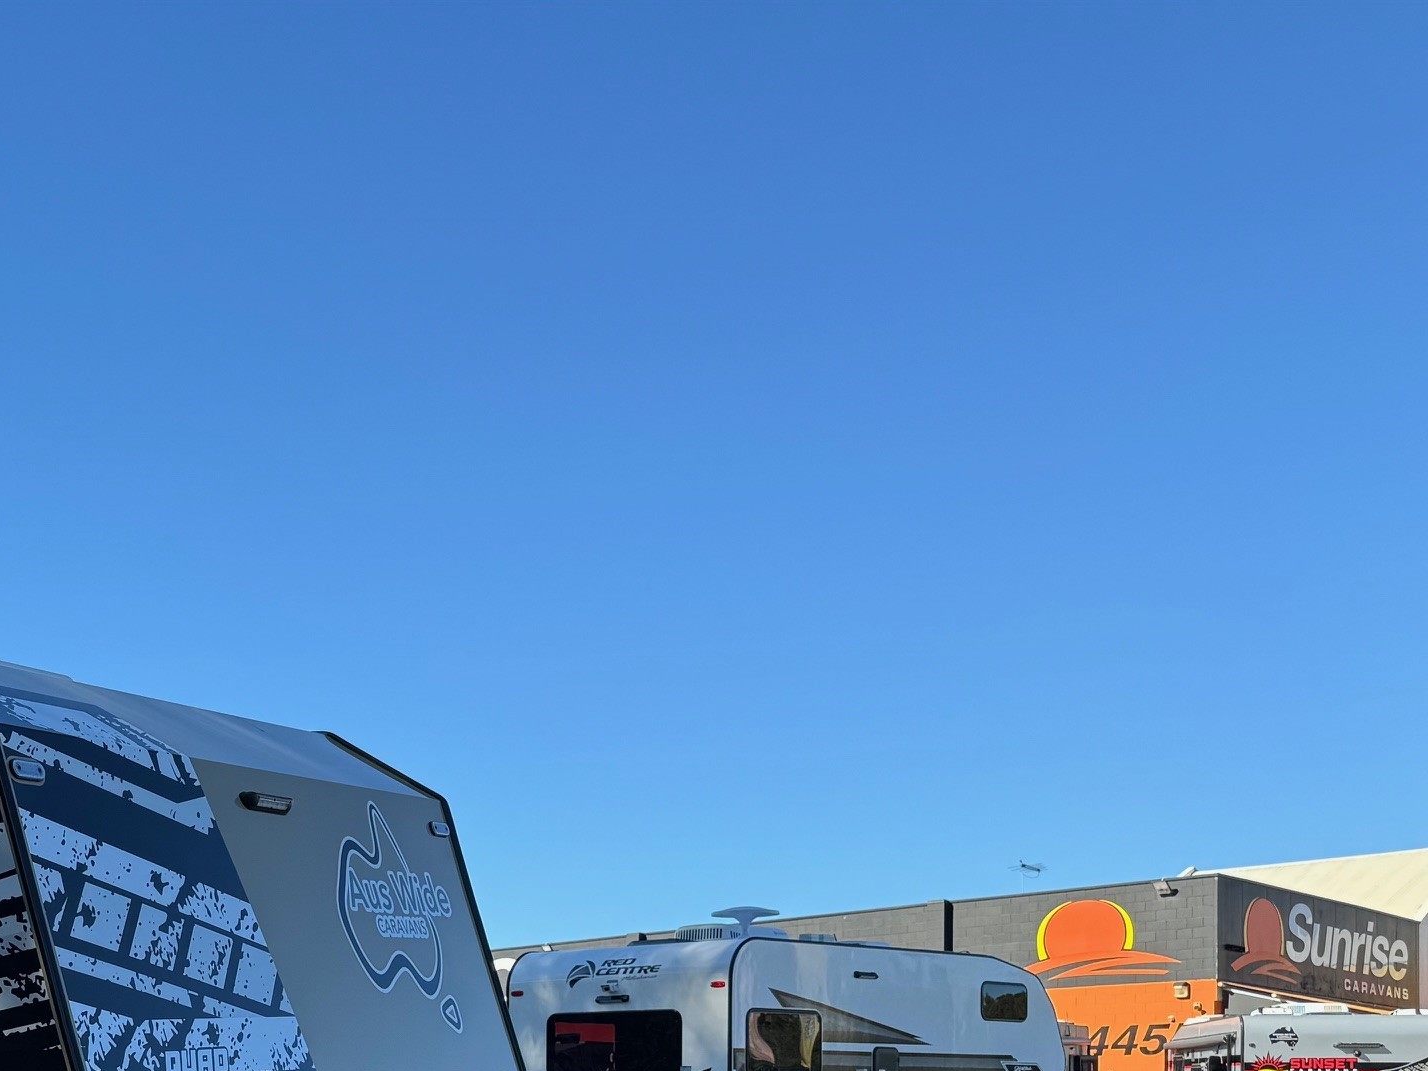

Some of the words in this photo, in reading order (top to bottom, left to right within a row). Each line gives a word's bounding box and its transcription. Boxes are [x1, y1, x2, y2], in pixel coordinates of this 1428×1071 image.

[348, 867, 394, 914] Aus
[387, 870, 452, 918] Wide
[376, 915, 429, 939] CARAVANS
[1286, 903, 1409, 981] Sunrise
[596, 965, 662, 976] CENTRE
[601, 958, 637, 967] RED
[1344, 978, 1409, 1000] CARAVANS
[1090, 1023, 1184, 1056] 445
[1290, 1057, 1358, 1070] SUNSET
